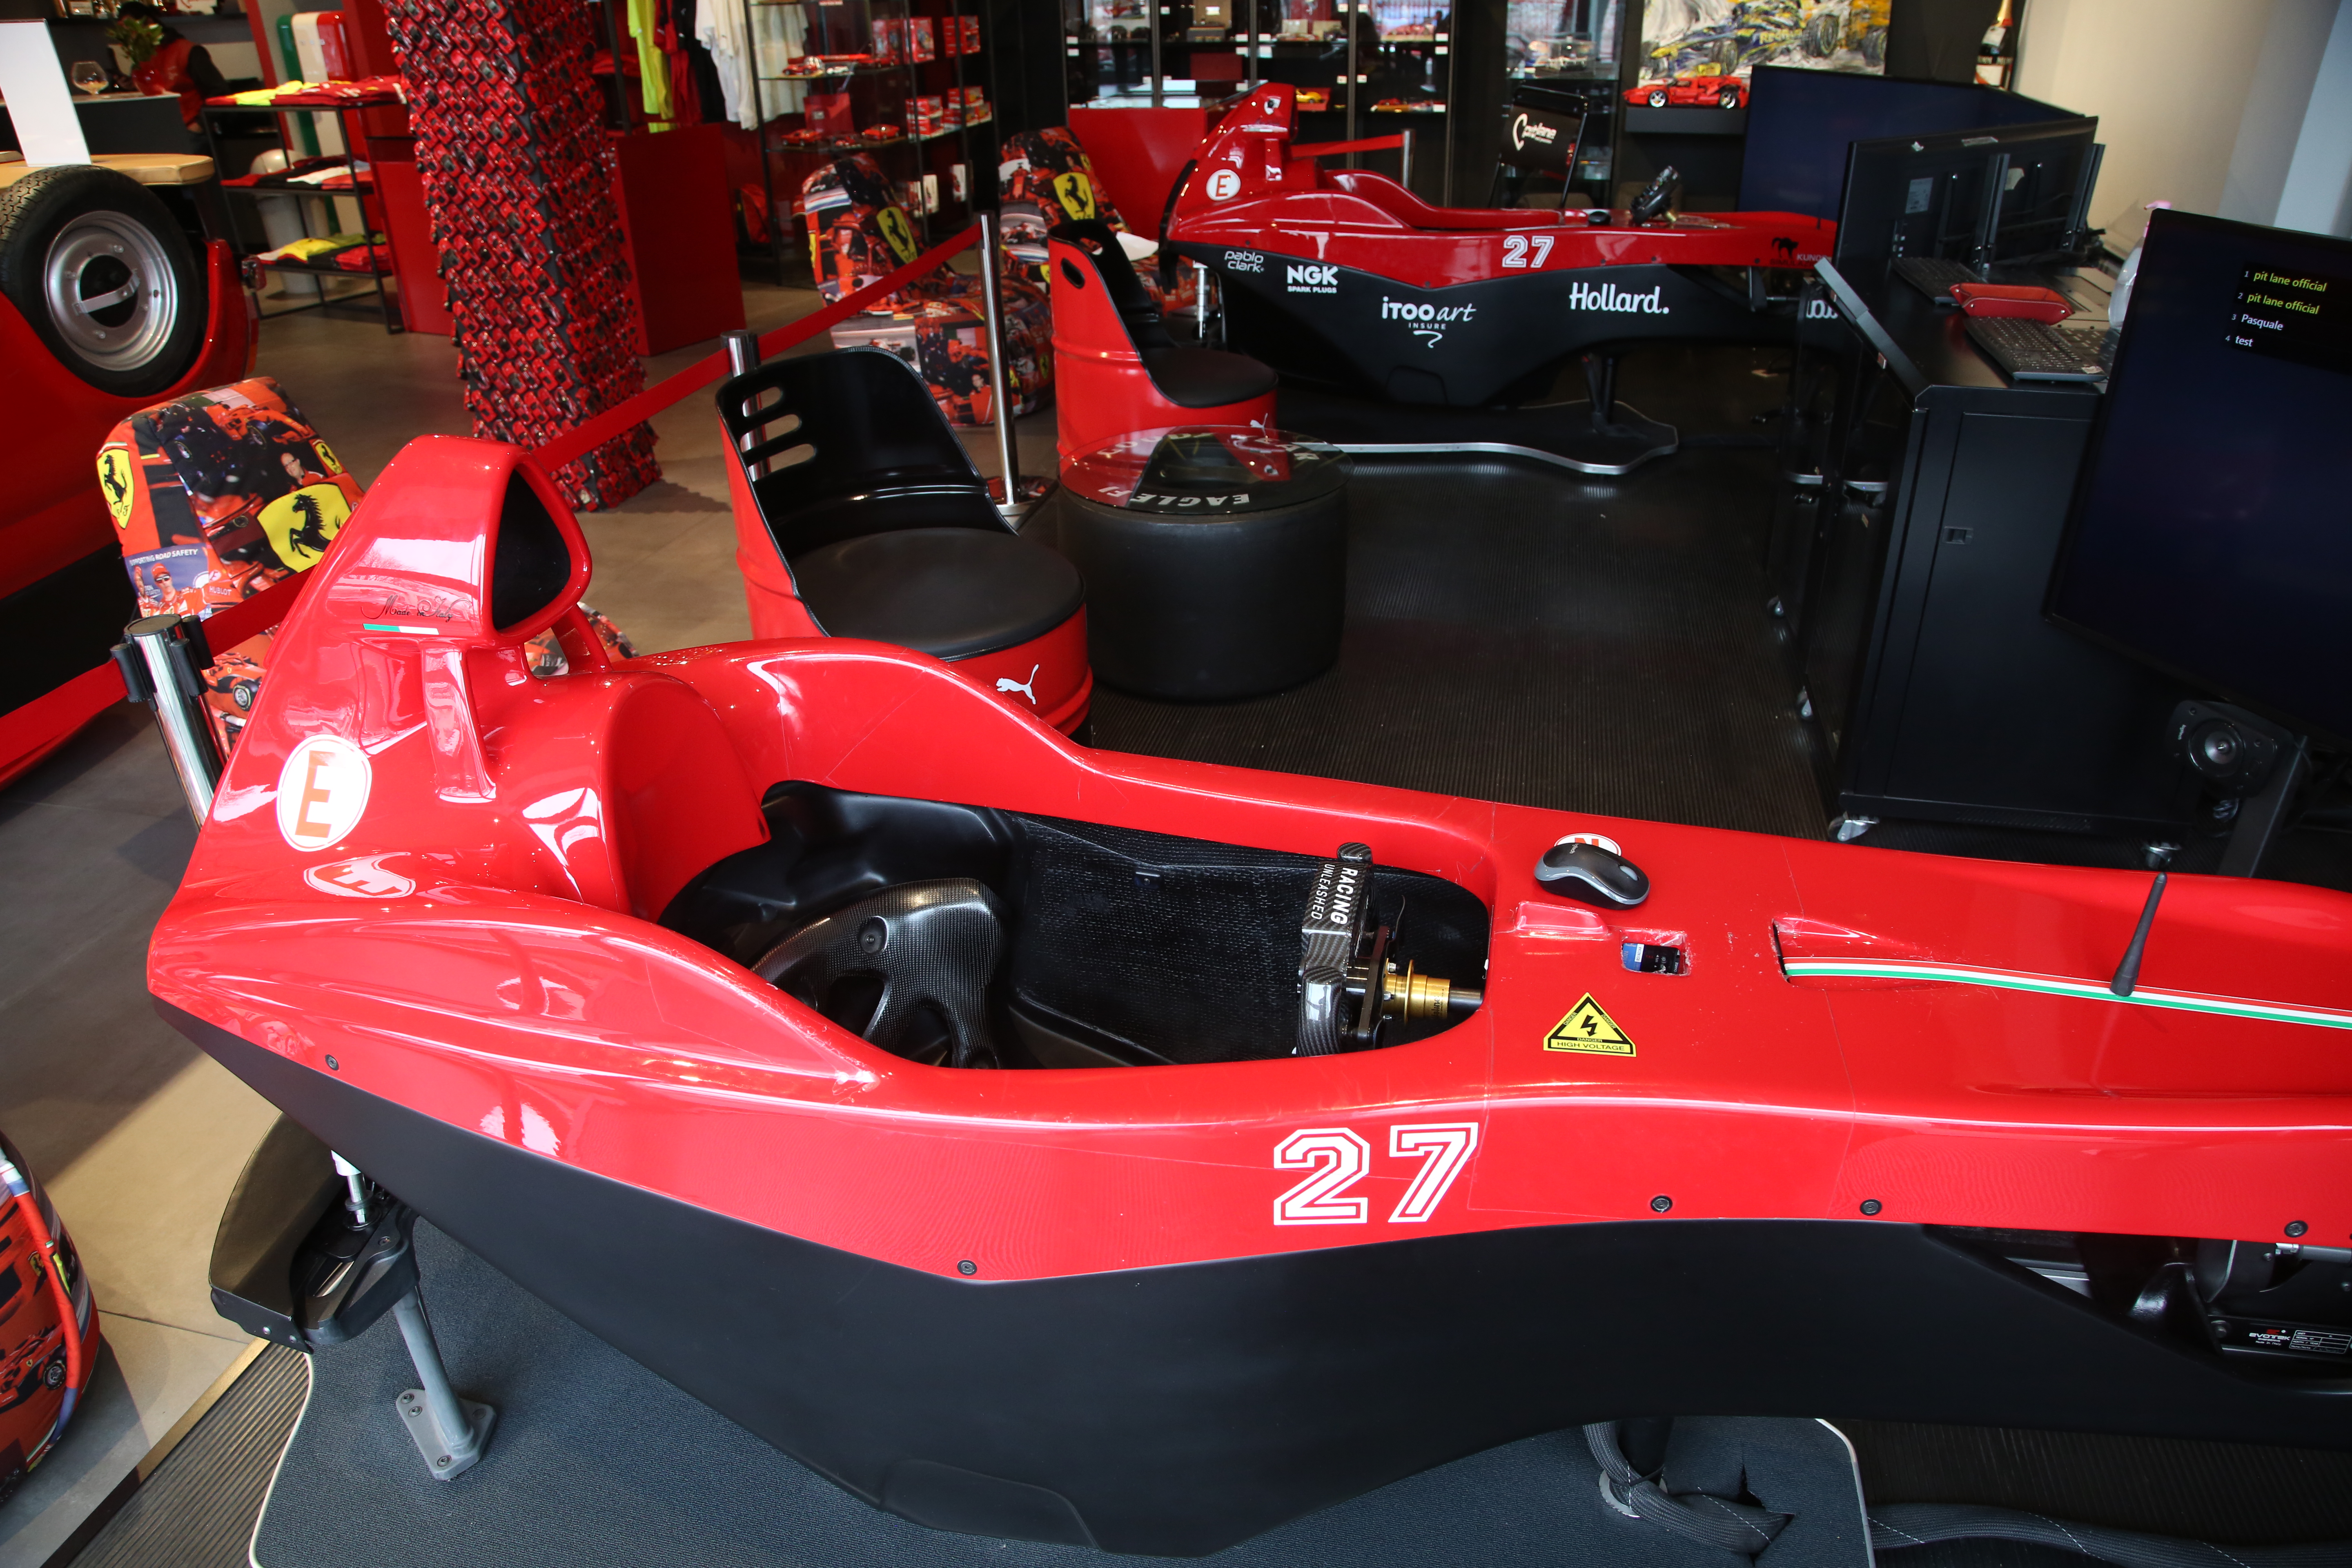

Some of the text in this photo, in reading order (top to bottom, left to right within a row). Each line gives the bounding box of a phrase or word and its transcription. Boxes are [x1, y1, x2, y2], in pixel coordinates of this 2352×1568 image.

[1215, 175, 1231, 197] E
[1224, 251, 1264, 264] pablo
[1502, 235, 1555, 268] 27
[1227, 260, 1261, 273] clark
[1287, 265, 1339, 286] NGK
[2253, 271, 2268, 281] pit
[2269, 273, 2290, 285] lane
[2292, 278, 2327, 292] official
[1569, 282, 1670, 314] Hollard.
[2247, 293, 2261, 303] pit
[2263, 295, 2283, 307] lane
[2285, 301, 2320, 314] official
[2241, 314, 2283, 331] Pasquale
[2235, 336, 2254, 347] test
[1131, 493, 1250, 507] EAGLE
[155, 552, 172, 561] ROAD
[172, 548, 198, 558] SAFETY
[209, 586, 232, 595] HUBLOT
[361, 595, 411, 619] Made
[295, 750, 346, 839] E
[1311, 864, 1336, 920] UNLEASHED
[1330, 867, 1358, 924] RACING
[1564, 1012, 1577, 1025] DANGER
[1601, 1014, 1616, 1029] DANGER
[1274, 1122, 1479, 1225] 27
